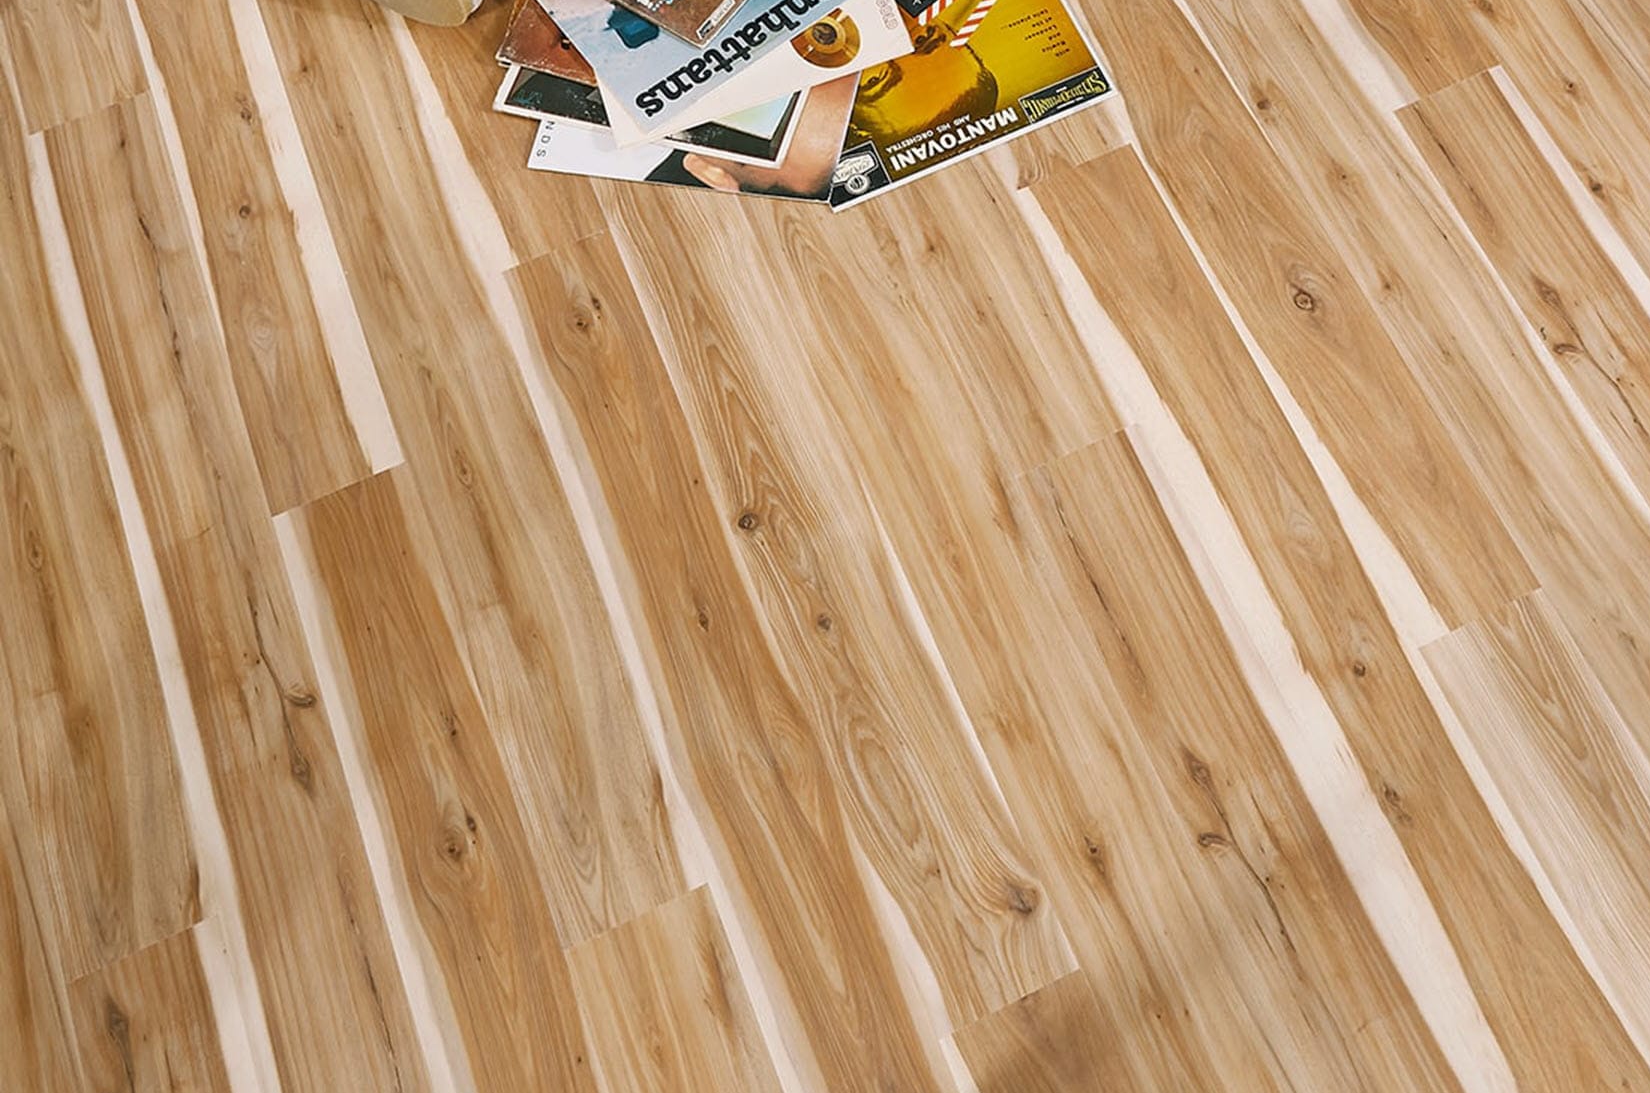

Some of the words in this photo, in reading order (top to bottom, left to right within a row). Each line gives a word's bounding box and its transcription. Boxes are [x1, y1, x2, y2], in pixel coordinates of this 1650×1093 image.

[936, 122, 951, 134] HIS
[953, 114, 972, 127] AND
[885, 130, 934, 153] ORCHESTRA
[890, 107, 1018, 171] MANTOVANI
